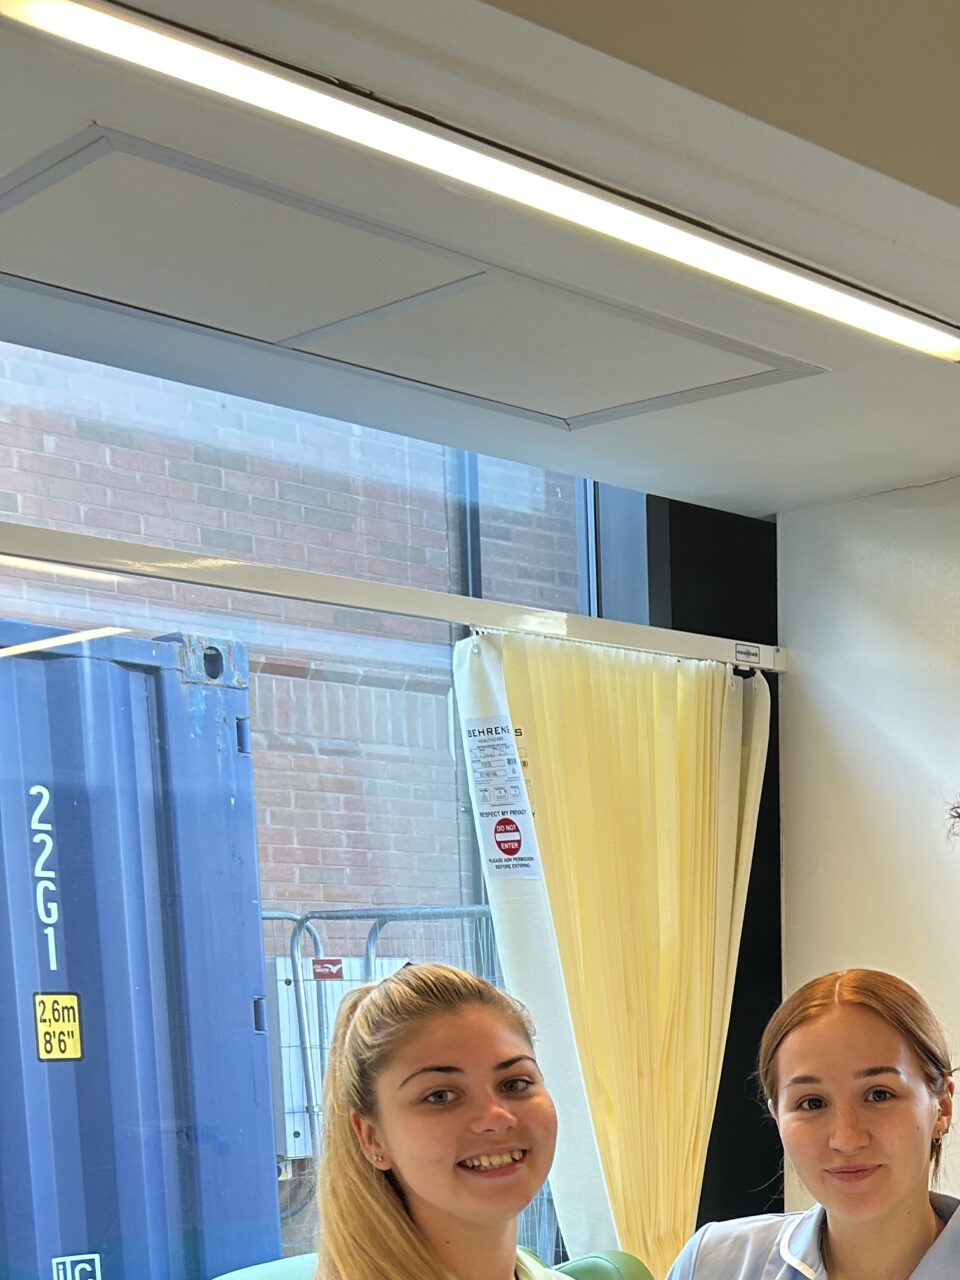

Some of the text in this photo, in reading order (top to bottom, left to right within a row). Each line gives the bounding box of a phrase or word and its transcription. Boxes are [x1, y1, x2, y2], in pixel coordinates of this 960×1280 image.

[468, 725, 510, 737] BEHRENS
[480, 810, 500, 818] RESPECT
[29, 785, 59, 971] 22G1
[38, 1000, 77, 1027] 2,6m
